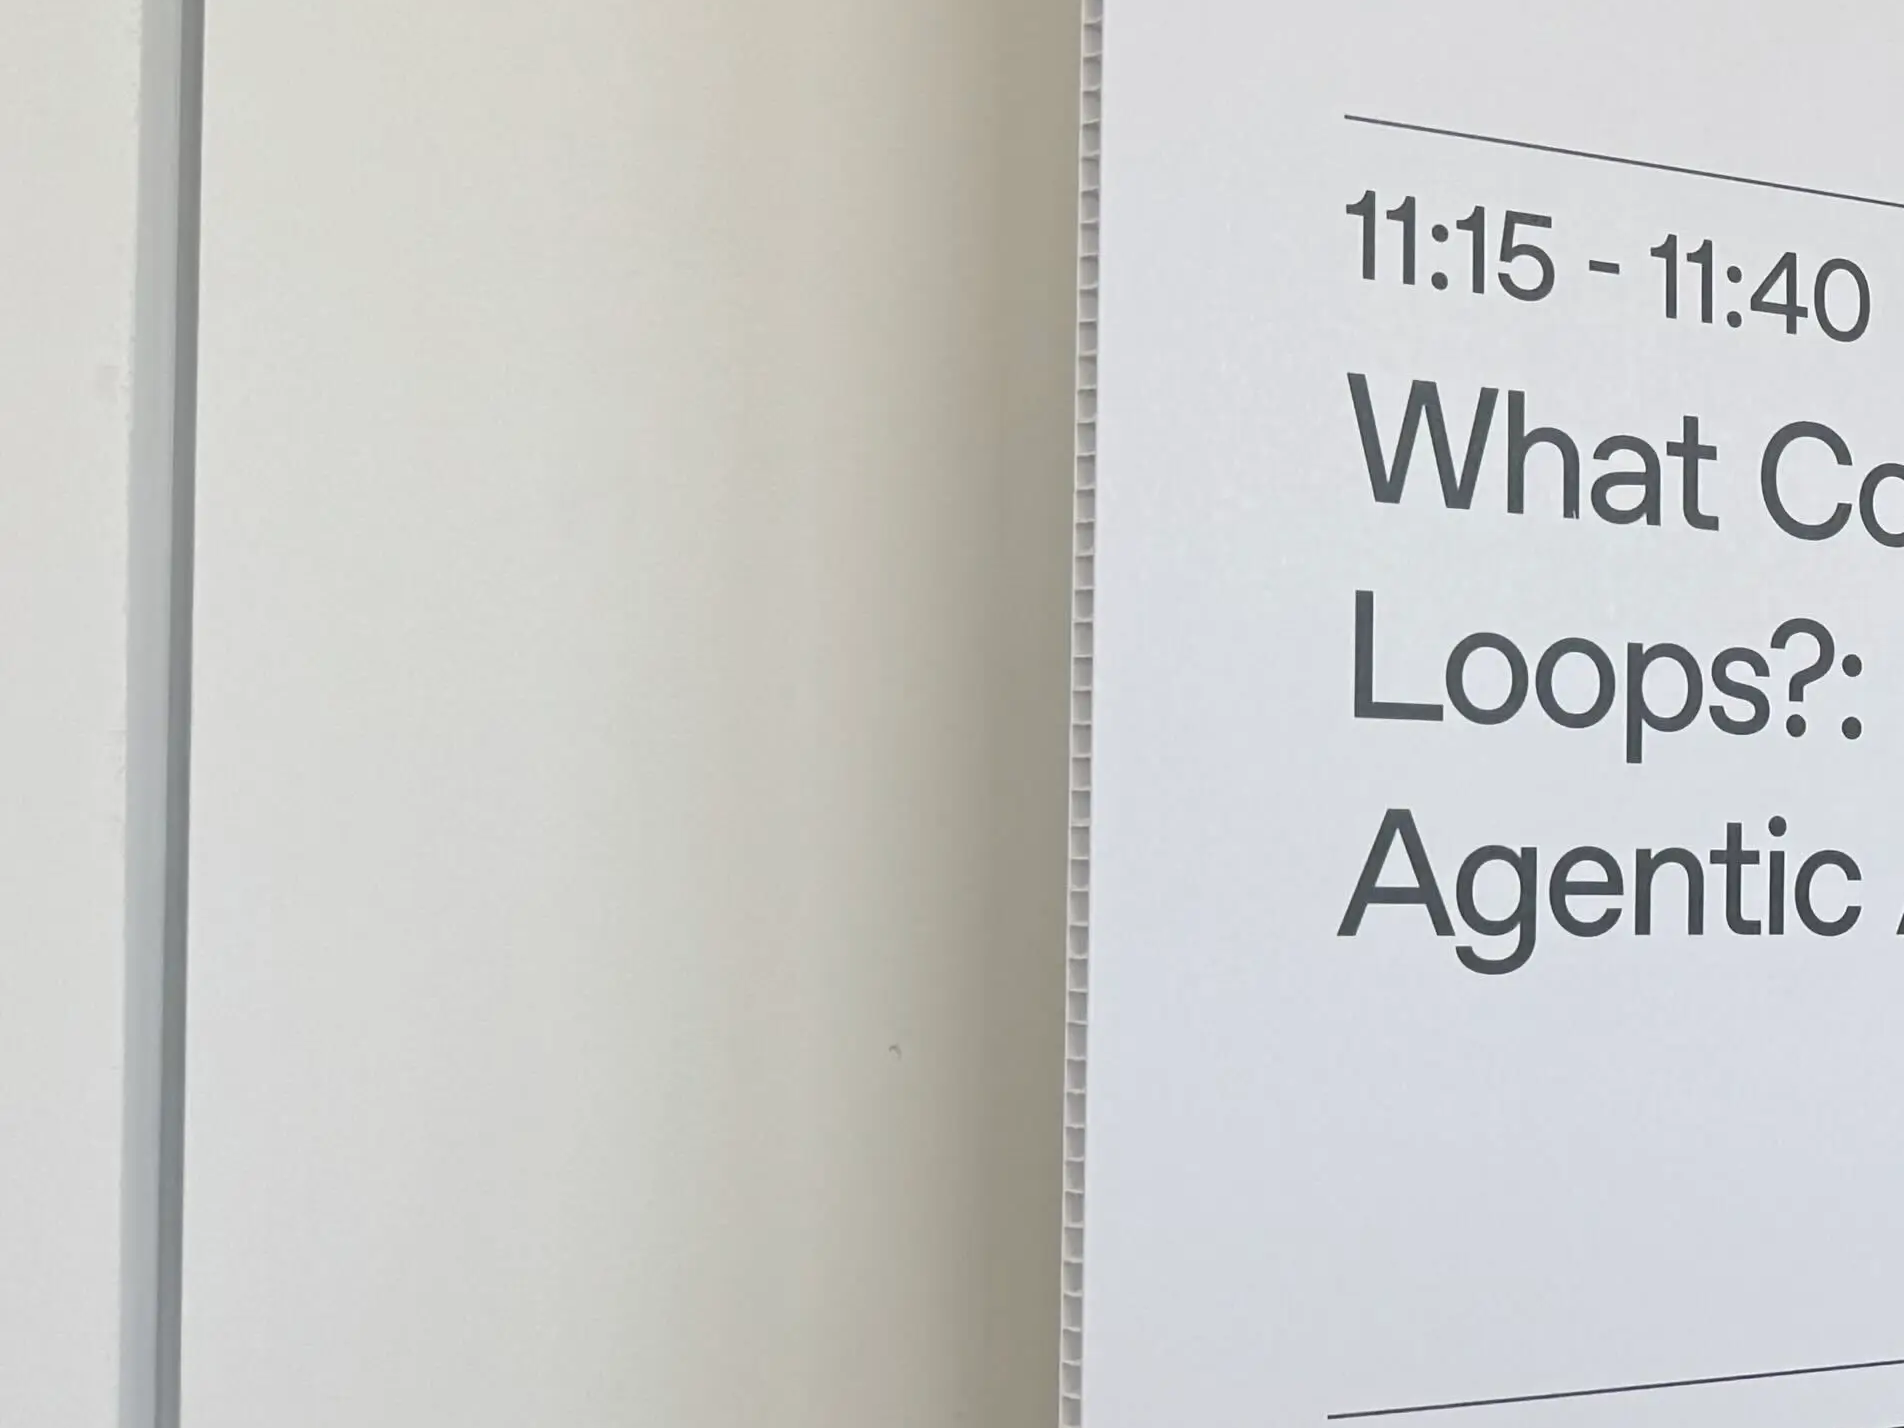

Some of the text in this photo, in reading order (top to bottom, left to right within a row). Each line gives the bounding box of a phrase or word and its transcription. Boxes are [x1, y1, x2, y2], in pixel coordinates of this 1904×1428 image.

[1345, 188, 1872, 344] 11:15 - 11:40
[1345, 371, 1720, 532] What
[1353, 588, 1863, 765] Loops?:
[1335, 807, 1863, 976] Agentic
